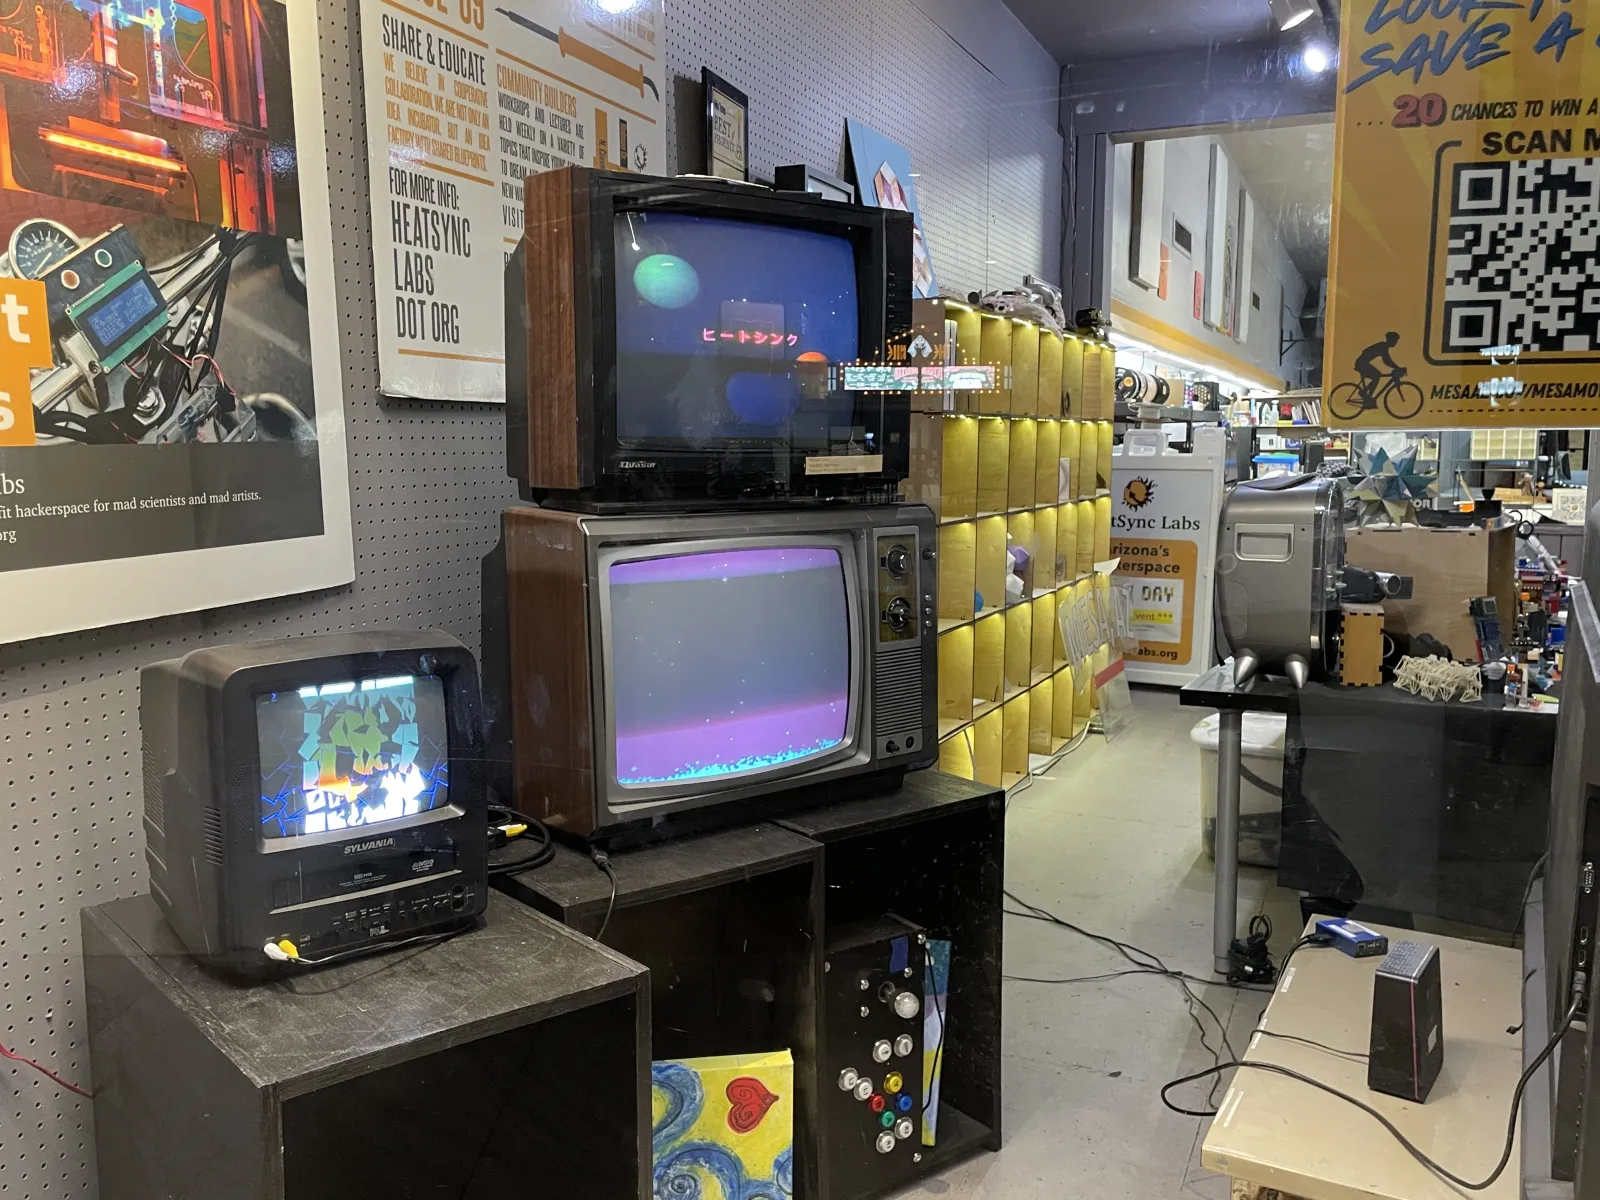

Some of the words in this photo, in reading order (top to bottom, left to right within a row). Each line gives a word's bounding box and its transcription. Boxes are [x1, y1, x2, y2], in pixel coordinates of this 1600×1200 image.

[382, 14, 424, 61] SHARE
[426, 33, 436, 66] &
[438, 37, 487, 86] EDUCATE
[383, 51, 396, 74] WE
[1343, 10, 1512, 94] SAVE
[1533, 11, 1585, 63] A
[496, 63, 543, 105] COMMUNITY
[544, 83, 578, 118] BUILDERS
[498, 90, 530, 119] WORKSHOPS
[535, 105, 545, 124] AND
[1391, 92, 1448, 128] 20
[1450, 101, 1518, 122] CHANCES
[1524, 99, 1543, 119] TO
[1550, 98, 1584, 118] WIN
[1481, 128, 1573, 156] SCAN
[389, 167, 407, 197] FOR
[409, 172, 436, 206] MORE
[436, 180, 460, 211] INFO:
[501, 181, 514, 200] NEW
[391, 199, 471, 258] HEATSYNC
[393, 248, 435, 296] LABS
[395, 295, 427, 341] DOT
[431, 301, 461, 344] ORG
[703, 328, 798, 347] ヒートシンク
[15, 503, 91, 518] hackerspace
[93, 499, 110, 512] for
[113, 496, 137, 511] mad
[140, 496, 187, 509] scientists
[188, 492, 207, 505] and
[209, 490, 230, 504] mad
[231, 490, 261, 502] artists.
[1111, 514, 1156, 531] tSync
[1161, 516, 1201, 531] Labs
[1110, 543, 1170, 557] rizona's
[1141, 584, 1175, 603] DAY
[1137, 647, 1179, 661] abs.org
[344, 838, 394, 854] SYLVANIA
